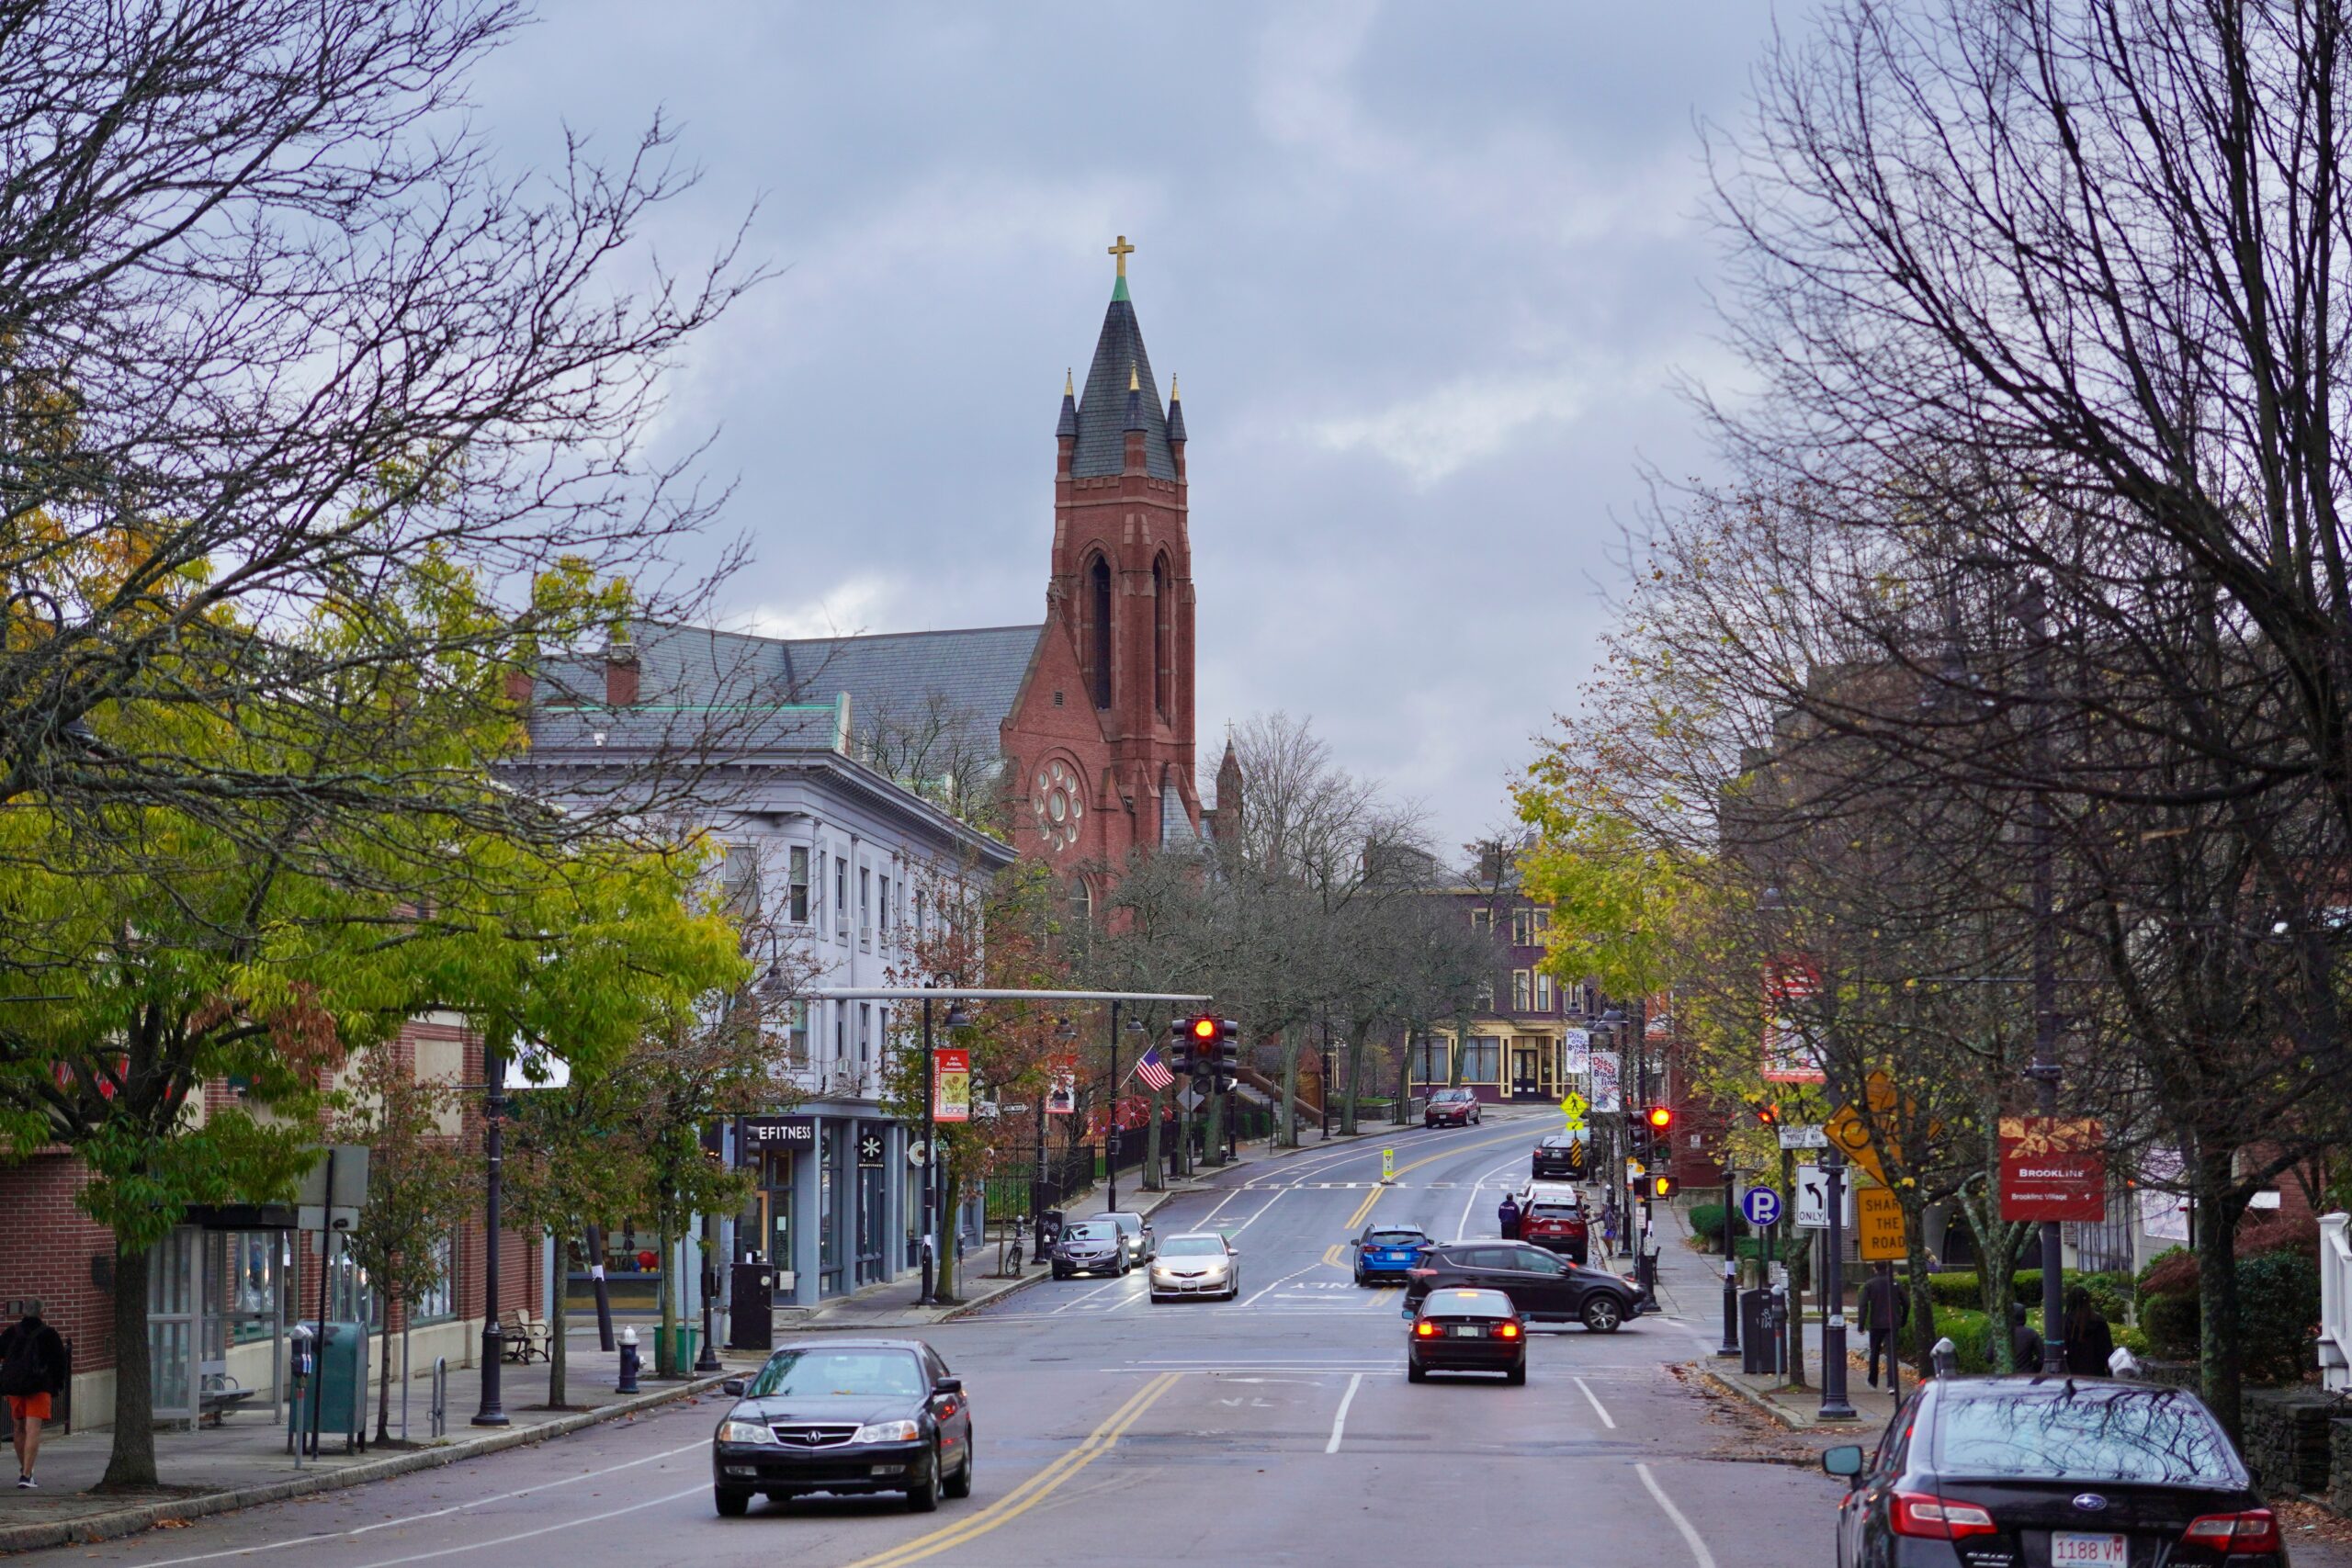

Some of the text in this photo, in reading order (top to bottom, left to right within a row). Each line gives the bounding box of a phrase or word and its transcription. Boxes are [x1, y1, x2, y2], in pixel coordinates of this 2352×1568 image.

[2018, 1168, 2085, 1178] BROOKLINE
[1752, 1192, 1776, 1221] P
[1866, 1199, 1901, 1212] SHAR
[1799, 1212, 1825, 1222] ONLY
[1876, 1217, 1900, 1230] THE
[1871, 1235, 1905, 1249] ROAD
[2057, 1541, 2123, 1562] 1188 VM
